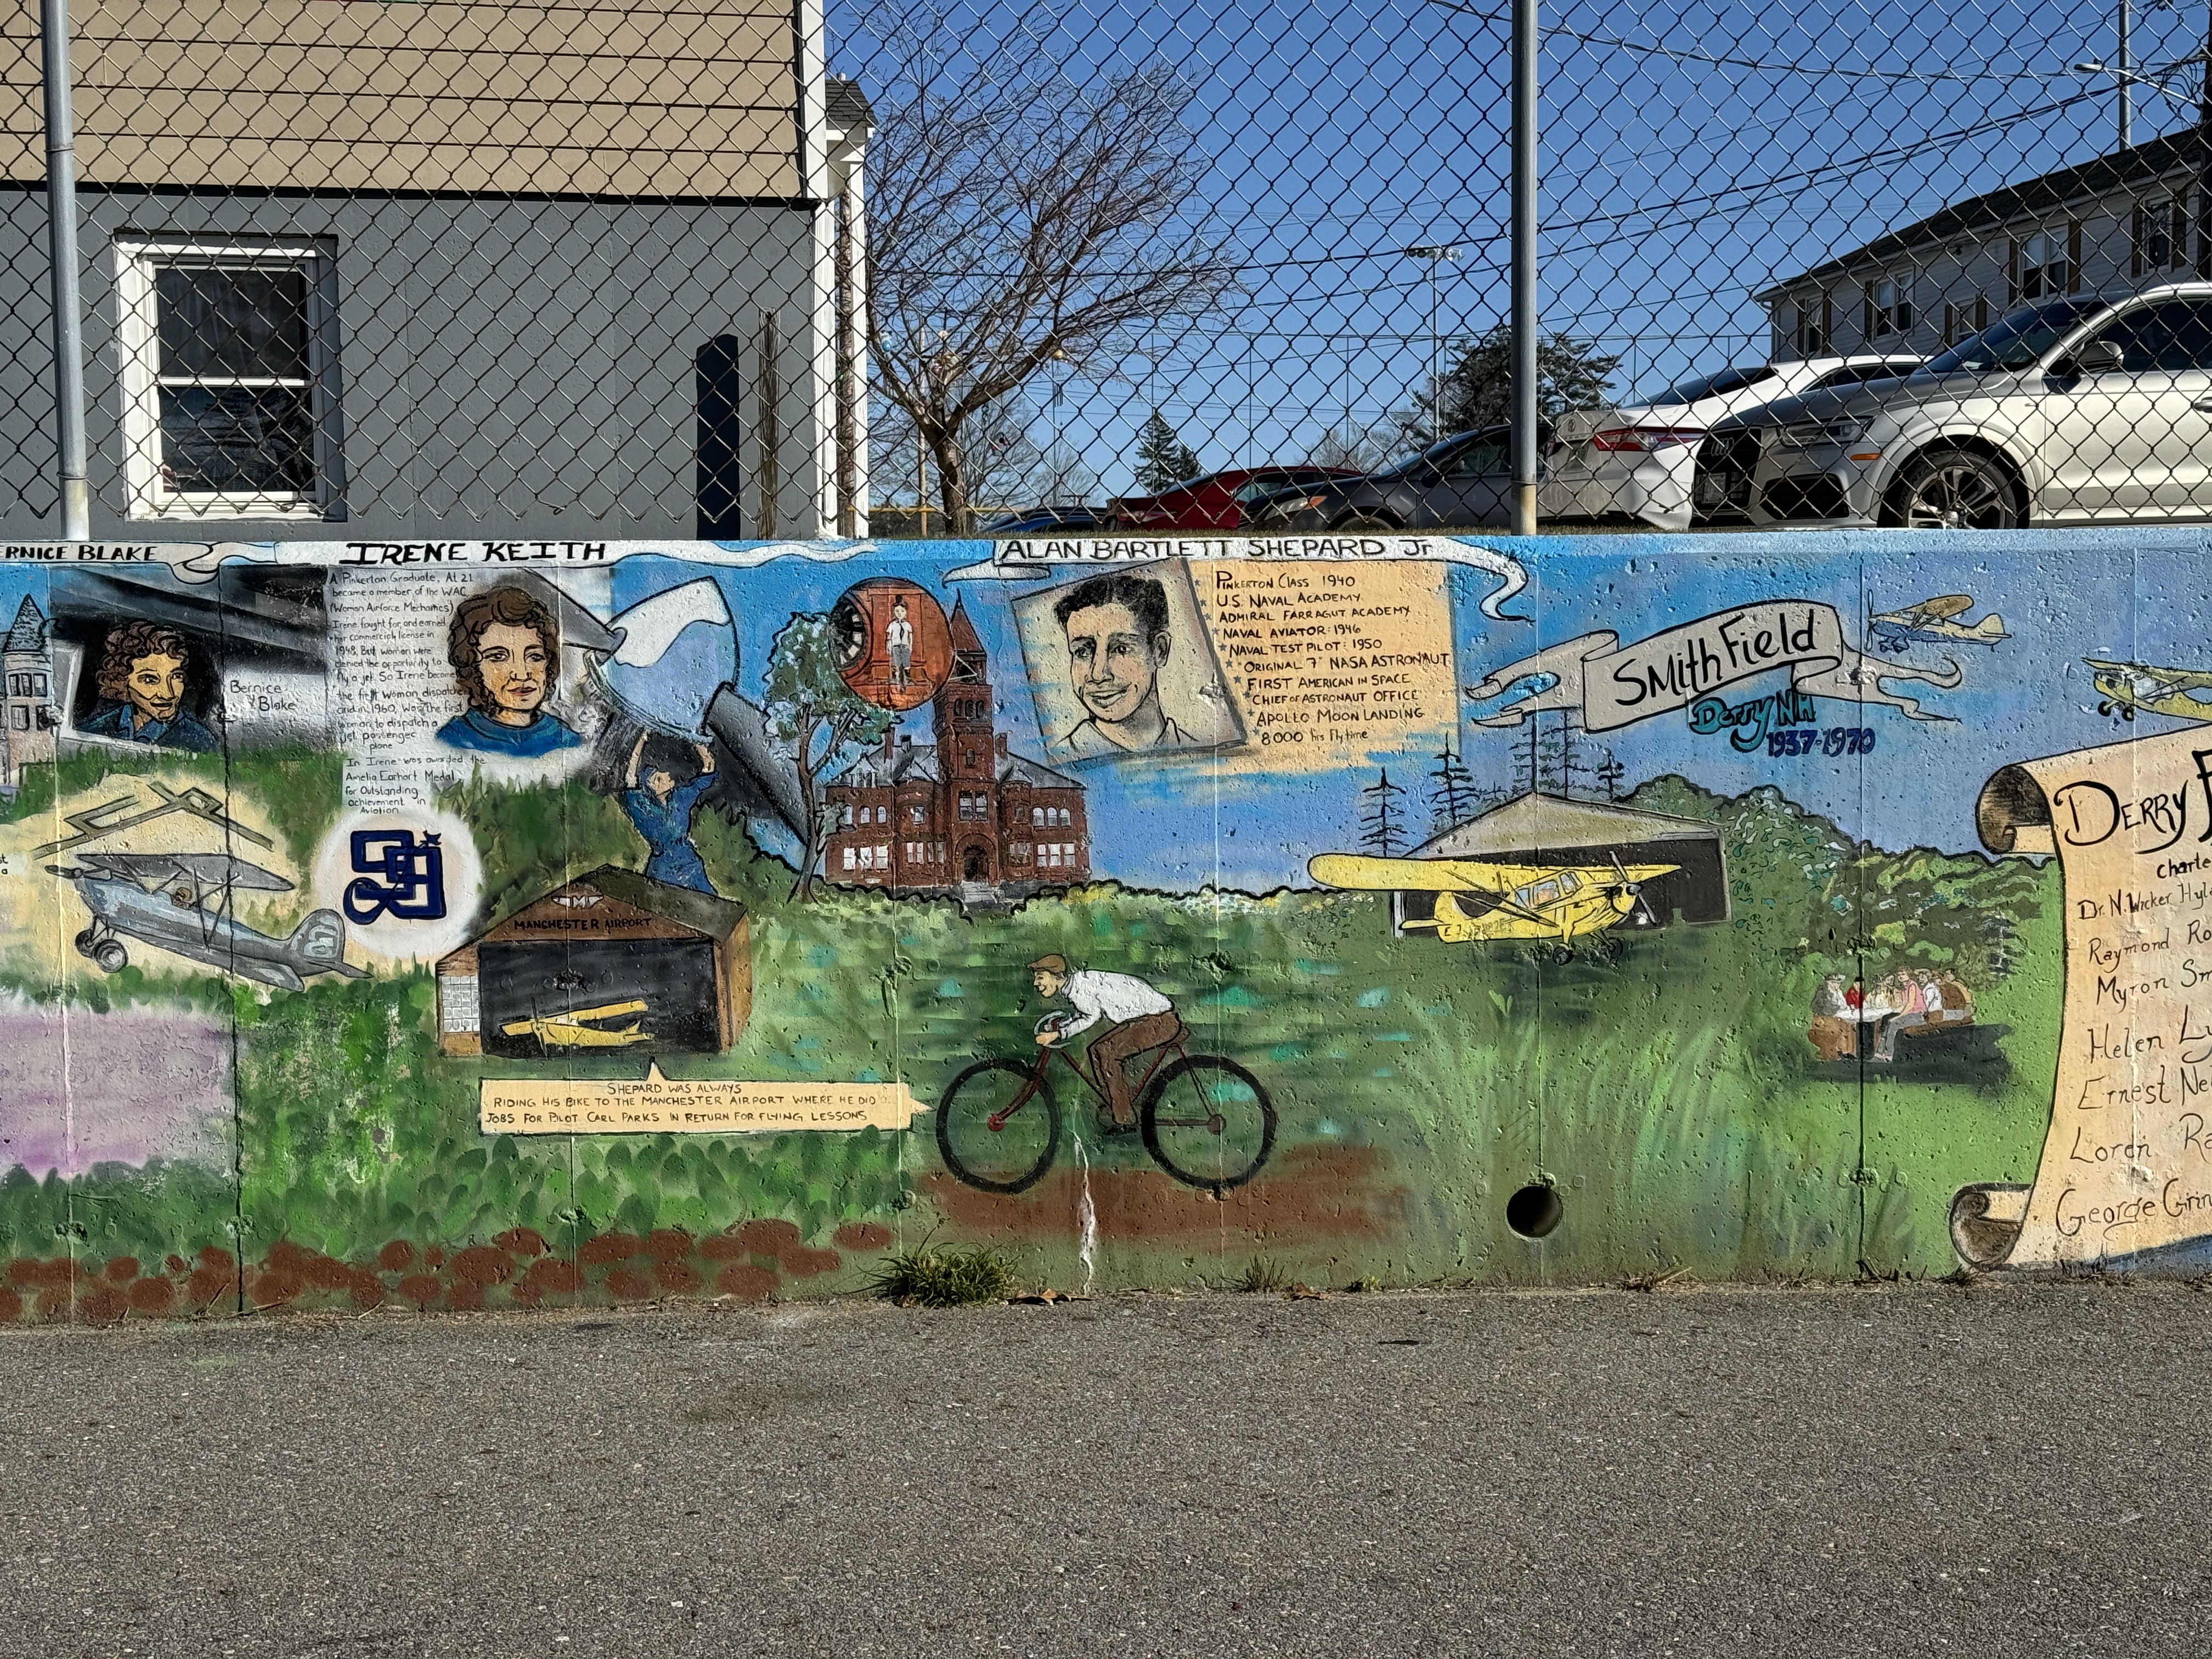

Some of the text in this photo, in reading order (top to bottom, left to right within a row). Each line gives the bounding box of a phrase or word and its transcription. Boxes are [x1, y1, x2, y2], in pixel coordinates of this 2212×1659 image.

[78, 545, 158, 561] BLAKE
[338, 541, 606, 566] IRENE KEITH
[1002, 539, 1432, 560] ALAN BARTLETT SHEPARD Jr
[330, 573, 338, 585] A
[342, 572, 387, 585] Pinkerton
[461, 573, 473, 582] 21
[1323, 575, 1356, 587] 1940
[332, 587, 366, 597] became
[377, 586, 412, 596] member
[415, 585, 425, 596] of
[442, 586, 467, 597] WAC
[1250, 594, 1294, 608] NAVAL
[1297, 592, 1361, 604] ACADEMY
[1219, 605, 1412, 624] ADMIRAL FARRAGUT ACADEMY
[361, 617, 386, 631] fought
[403, 617, 417, 627] and
[399, 630, 425, 639] license
[1223, 628, 1263, 640] NAVAL
[1229, 644, 1268, 658] NAVAL
[1271, 643, 1304, 654] TEST
[1353, 638, 1382, 651] 1950
[1330, 655, 1368, 670] NASA
[1372, 652, 1450, 668] ASTRONAUT
[379, 671, 393, 682] So
[396, 670, 425, 680] Irene
[1248, 674, 1410, 691] FIRST AMERICAN IN SPACE
[258, 696, 297, 712] Blake
[444, 700, 464, 713] first
[1252, 695, 1289, 706] CHIEF
[1301, 692, 1368, 704] ASTRONAUT
[374, 717, 384, 729] to
[387, 716, 429, 731] dispatch
[1257, 707, 1425, 727] APOLLO MOON LANDING
[1690, 690, 1816, 753] Derry NH
[1262, 731, 1304, 746] 8000
[1767, 727, 1876, 758] 1937-1970
[366, 757, 397, 766] Irene
[346, 769, 454, 782] Amelia Earhart Medal
[345, 784, 419, 799] for Outstanding
[2157, 852, 2212, 878] charte
[514, 917, 652, 930] MANCHESTER AIRPORT
[2089, 928, 2170, 974] Raymond
[2096, 975, 2170, 1014] Myron
[2087, 1023, 2165, 1064] Helen
[607, 1083, 742, 1095] SHEPARD WAS ALWAYS
[2078, 1065, 2212, 1110] Ernest Ne
[494, 1095, 876, 1108] RIDING HIS BIKE TO THE MANCHESTER AIRPORT WHERE HE DID
[486, 1110, 867, 1124] JOBS FOR PILOT CARL PARKS IN RETURN FOR FLYING LESSONS
[2070, 1126, 2152, 1164] Loren
[2056, 1188, 2156, 1242] George
